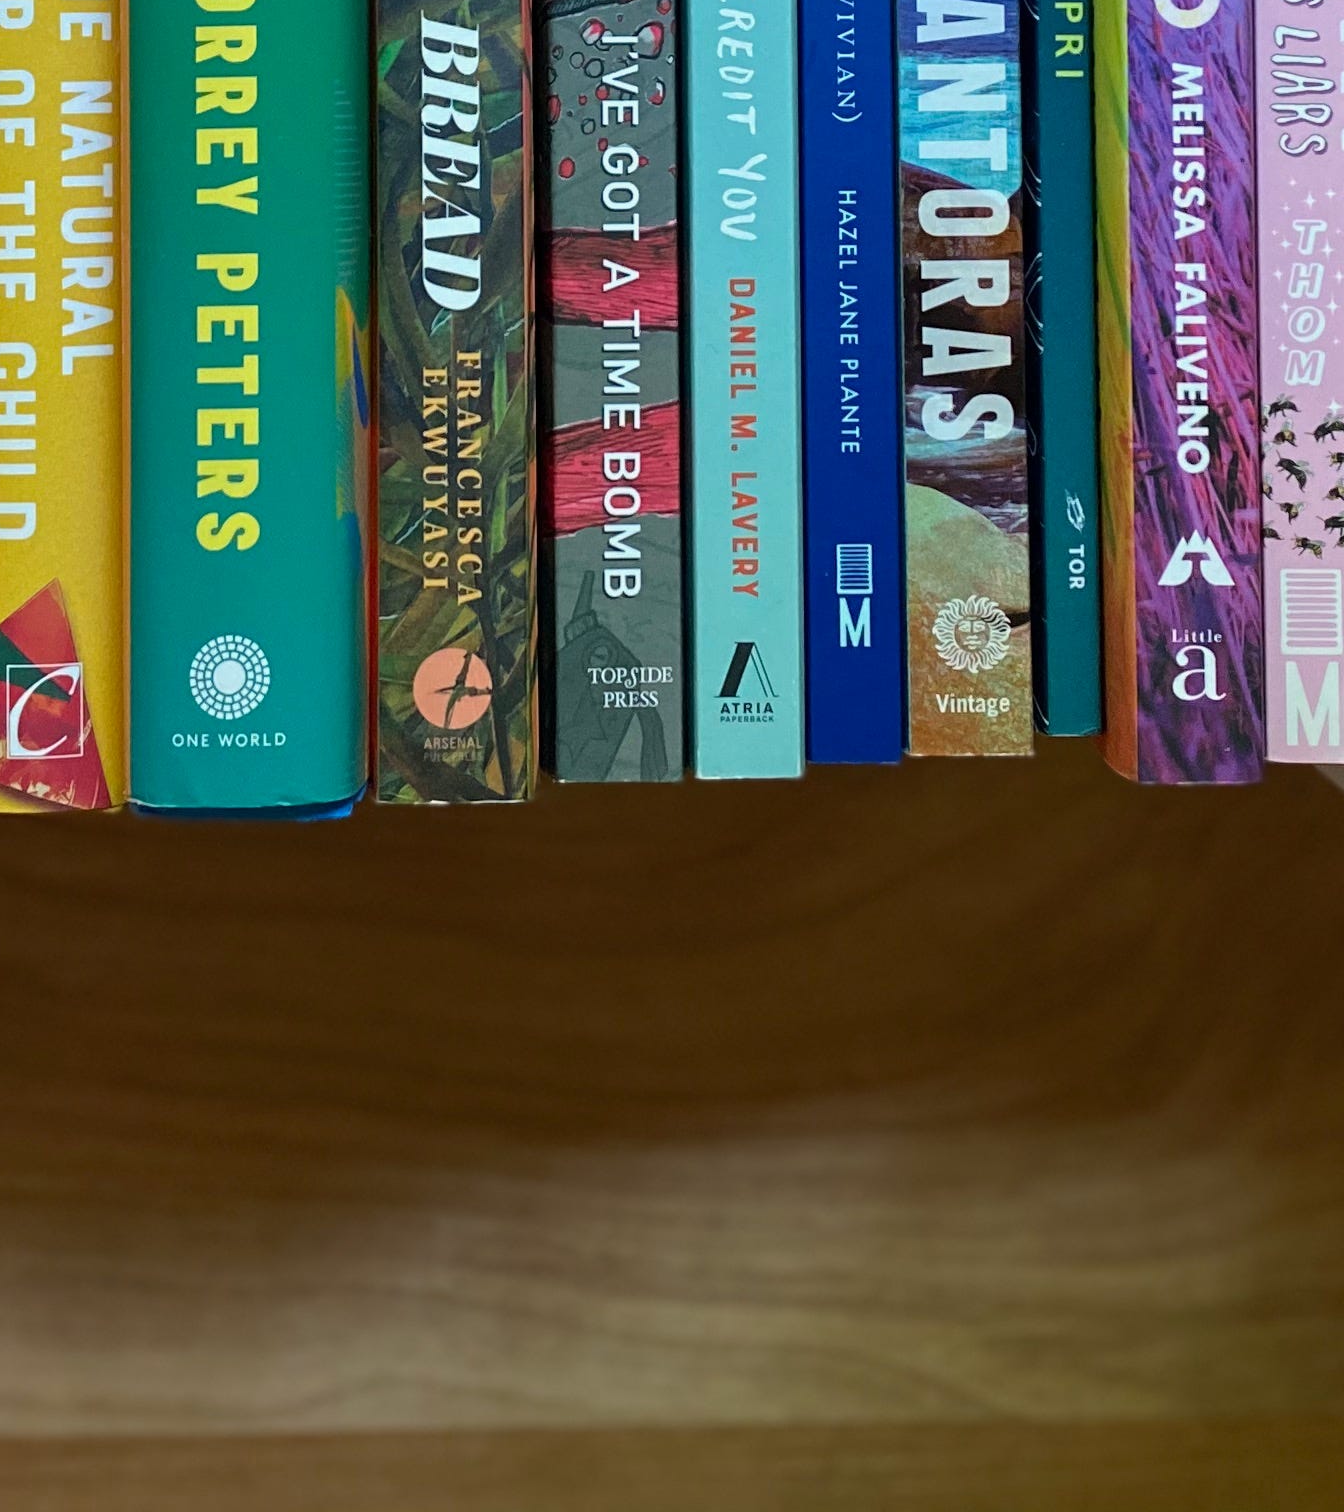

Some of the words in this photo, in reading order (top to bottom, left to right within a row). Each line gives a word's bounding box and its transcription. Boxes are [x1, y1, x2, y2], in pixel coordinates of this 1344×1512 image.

[1270, 25, 1336, 157] LIARS
[420, 10, 482, 311] BREAD
[718, 153, 767, 242] YOU
[60, 81, 114, 376] NATURAL
[838, 190, 858, 269] HAZEL
[838, 282, 858, 346] JANE
[196, 253, 260, 552] PETERS
[840, 360, 861, 454] PLANTE
[1068, 545, 1085, 590] TOR
[1172, 630, 1222, 643] Little
[588, 666, 673, 687] TOPSIDE
[603, 691, 659, 708] PRESS
[720, 702, 774, 714] ATRIA
[720, 715, 774, 723] PAPERBACK
[936, 693, 1010, 716] Vintage
[172, 733, 211, 748] ONE
[218, 732, 287, 748] WORLD
[423, 736, 484, 750] ARSENAL
